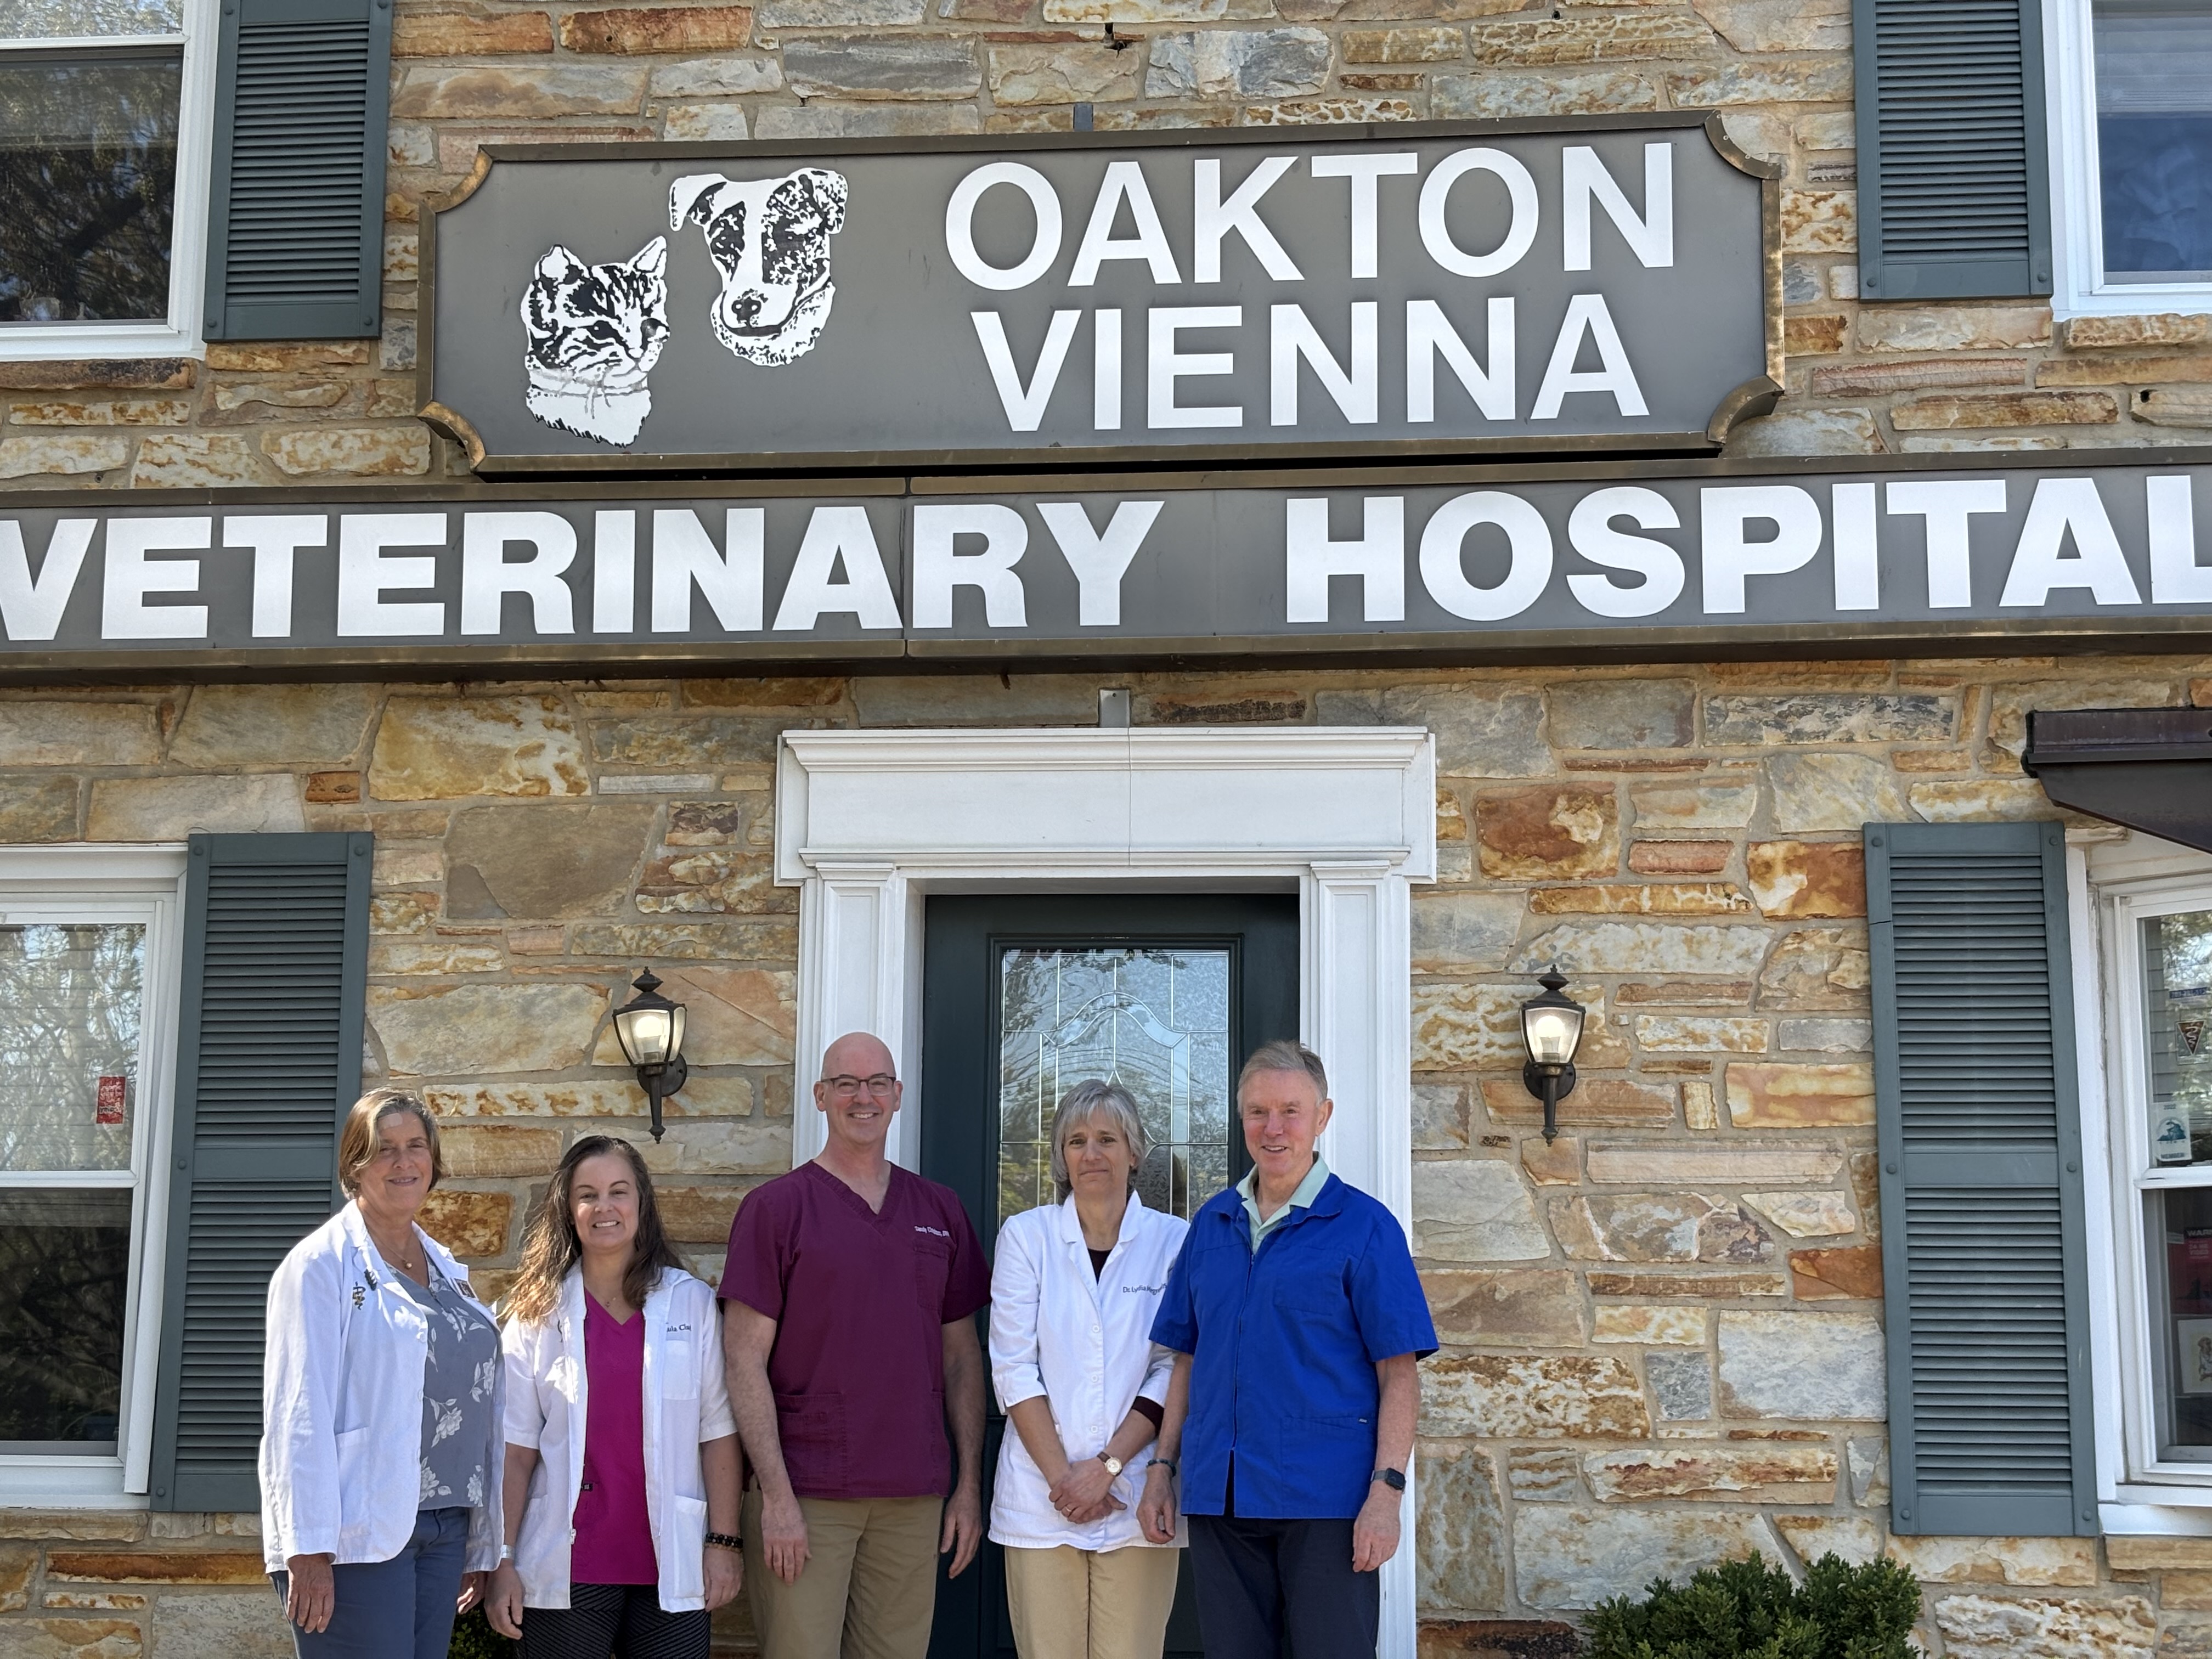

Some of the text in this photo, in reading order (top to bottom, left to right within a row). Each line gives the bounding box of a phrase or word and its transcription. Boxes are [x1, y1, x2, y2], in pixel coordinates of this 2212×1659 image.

[945, 142, 1674, 291] OAKTON
[969, 294, 1650, 432] VIENNA
[0, 474, 2212, 641] VETERINARY HOSPITAL
